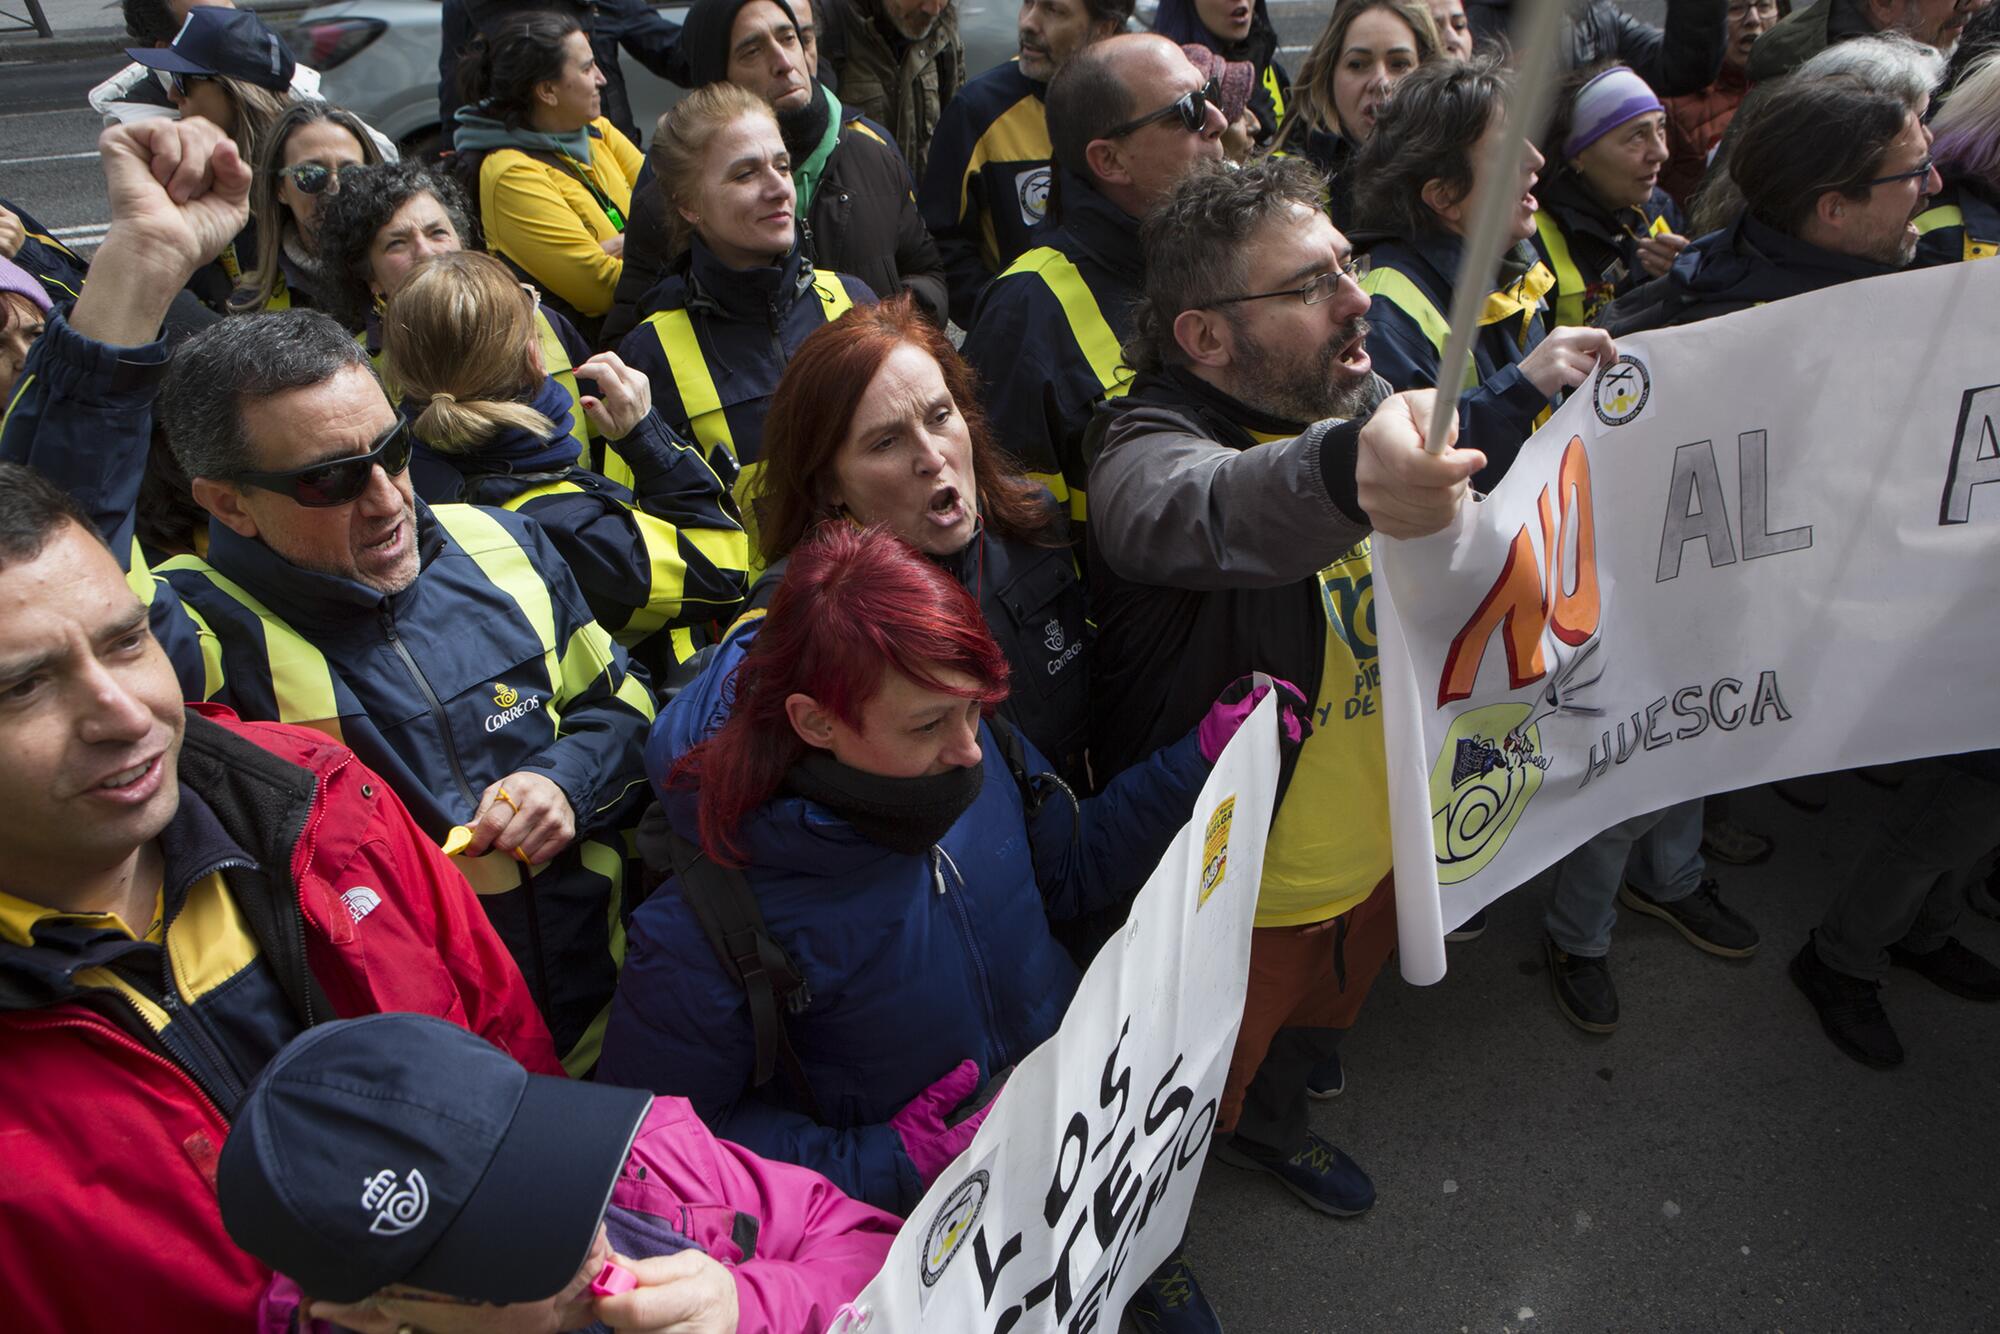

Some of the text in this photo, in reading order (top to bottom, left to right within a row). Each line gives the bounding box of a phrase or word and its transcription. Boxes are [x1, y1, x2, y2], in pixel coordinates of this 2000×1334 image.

[1437, 435, 1601, 710] NO
[1655, 428, 1814, 583] AL
[1047, 641, 1083, 676] Correos
[485, 694, 540, 732] CORREOS
[1317, 702, 1332, 727] Y
[1579, 670, 1791, 789] HUESCA
[972, 1014, 1131, 1312] LOS
